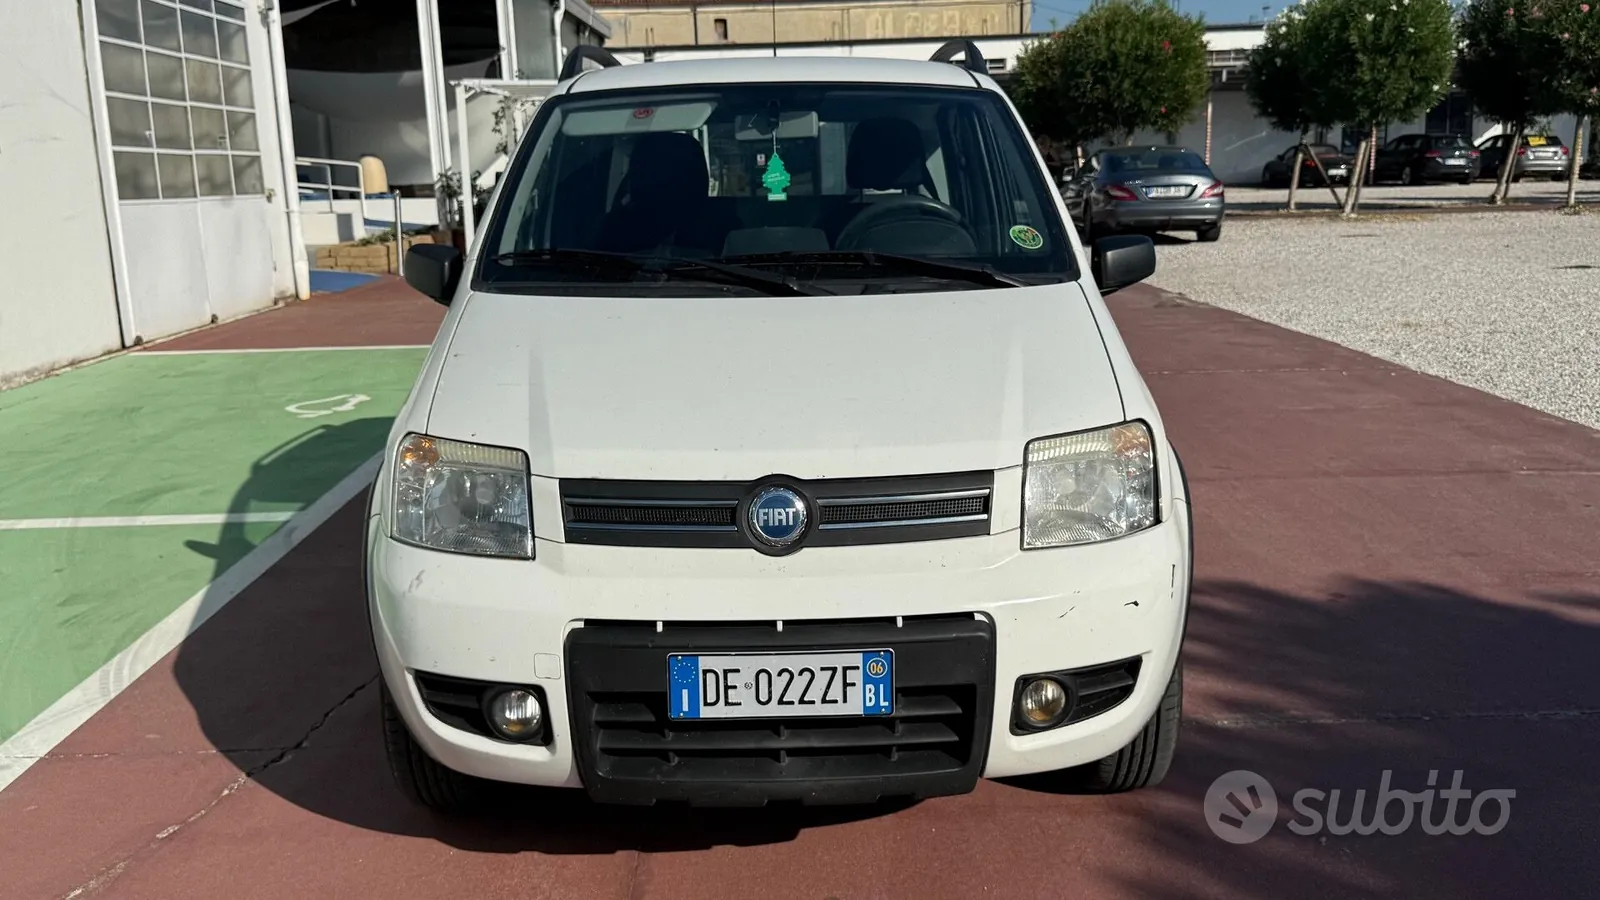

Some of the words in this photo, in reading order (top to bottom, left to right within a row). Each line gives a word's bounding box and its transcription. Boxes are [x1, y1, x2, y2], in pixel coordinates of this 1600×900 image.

[758, 507, 797, 527] FIAT
[869, 663, 884, 675] 06
[702, 668, 742, 707] DE
[754, 665, 861, 706] 022ZF
[865, 683, 889, 707] BL
